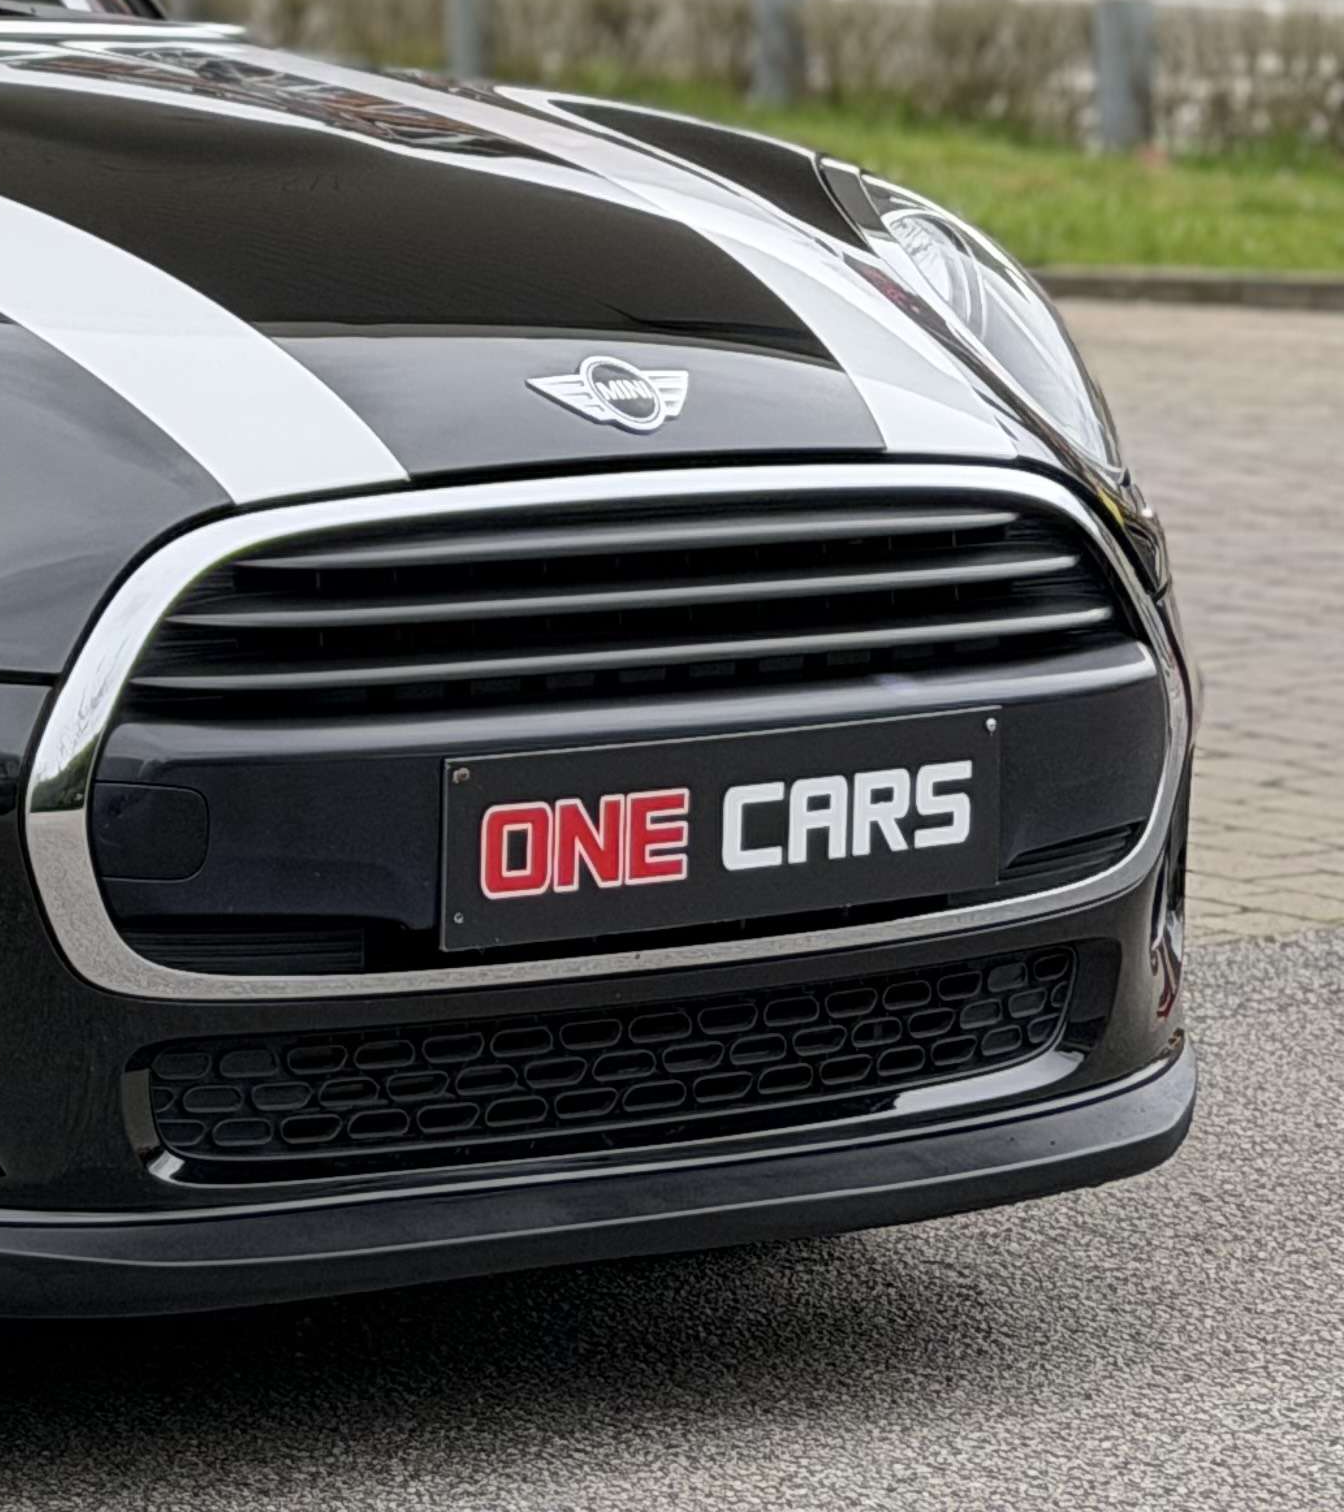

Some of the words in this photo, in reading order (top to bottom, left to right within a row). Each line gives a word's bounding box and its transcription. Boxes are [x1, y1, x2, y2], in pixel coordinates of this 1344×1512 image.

[595, 379, 654, 400] MINI
[481, 788, 690, 900] ONE
[721, 760, 973, 871] CARS
